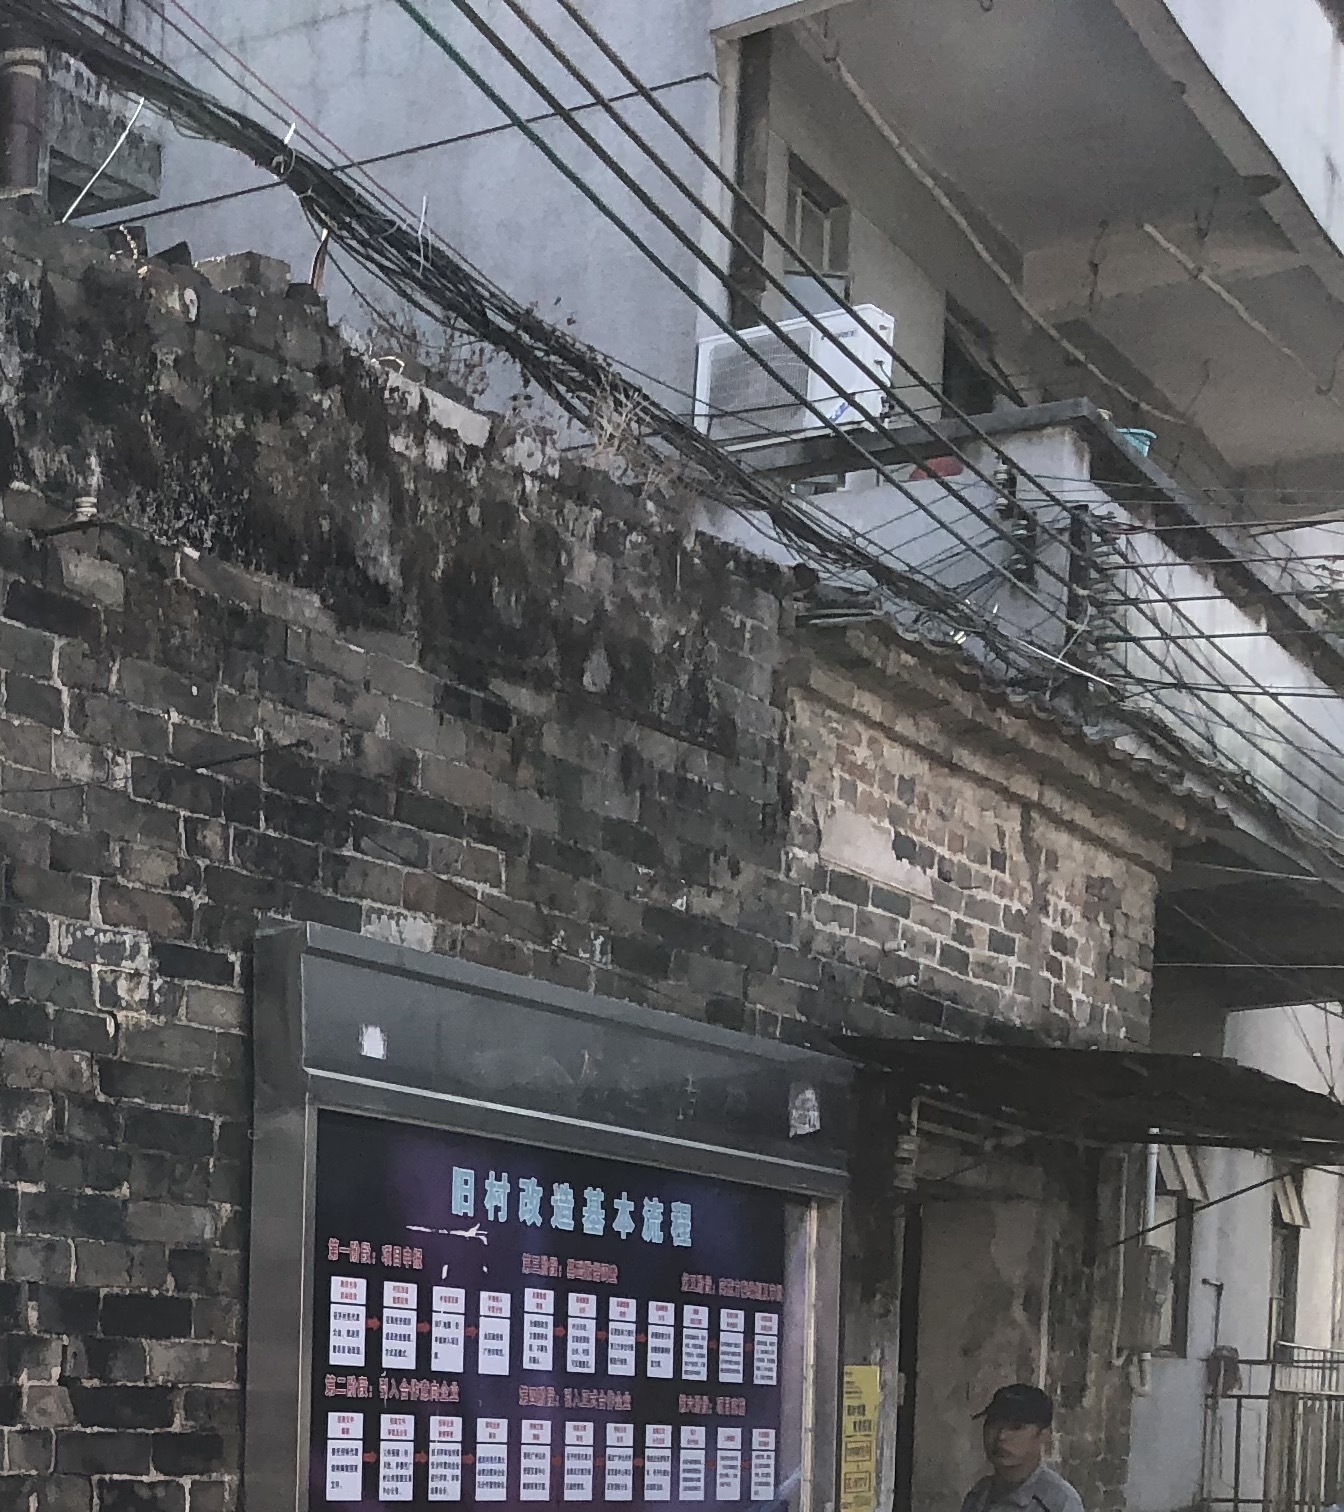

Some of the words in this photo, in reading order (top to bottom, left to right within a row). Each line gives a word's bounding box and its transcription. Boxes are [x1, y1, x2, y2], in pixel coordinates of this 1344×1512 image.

[451, 1165, 692, 1248] 旧村改造基本流程
